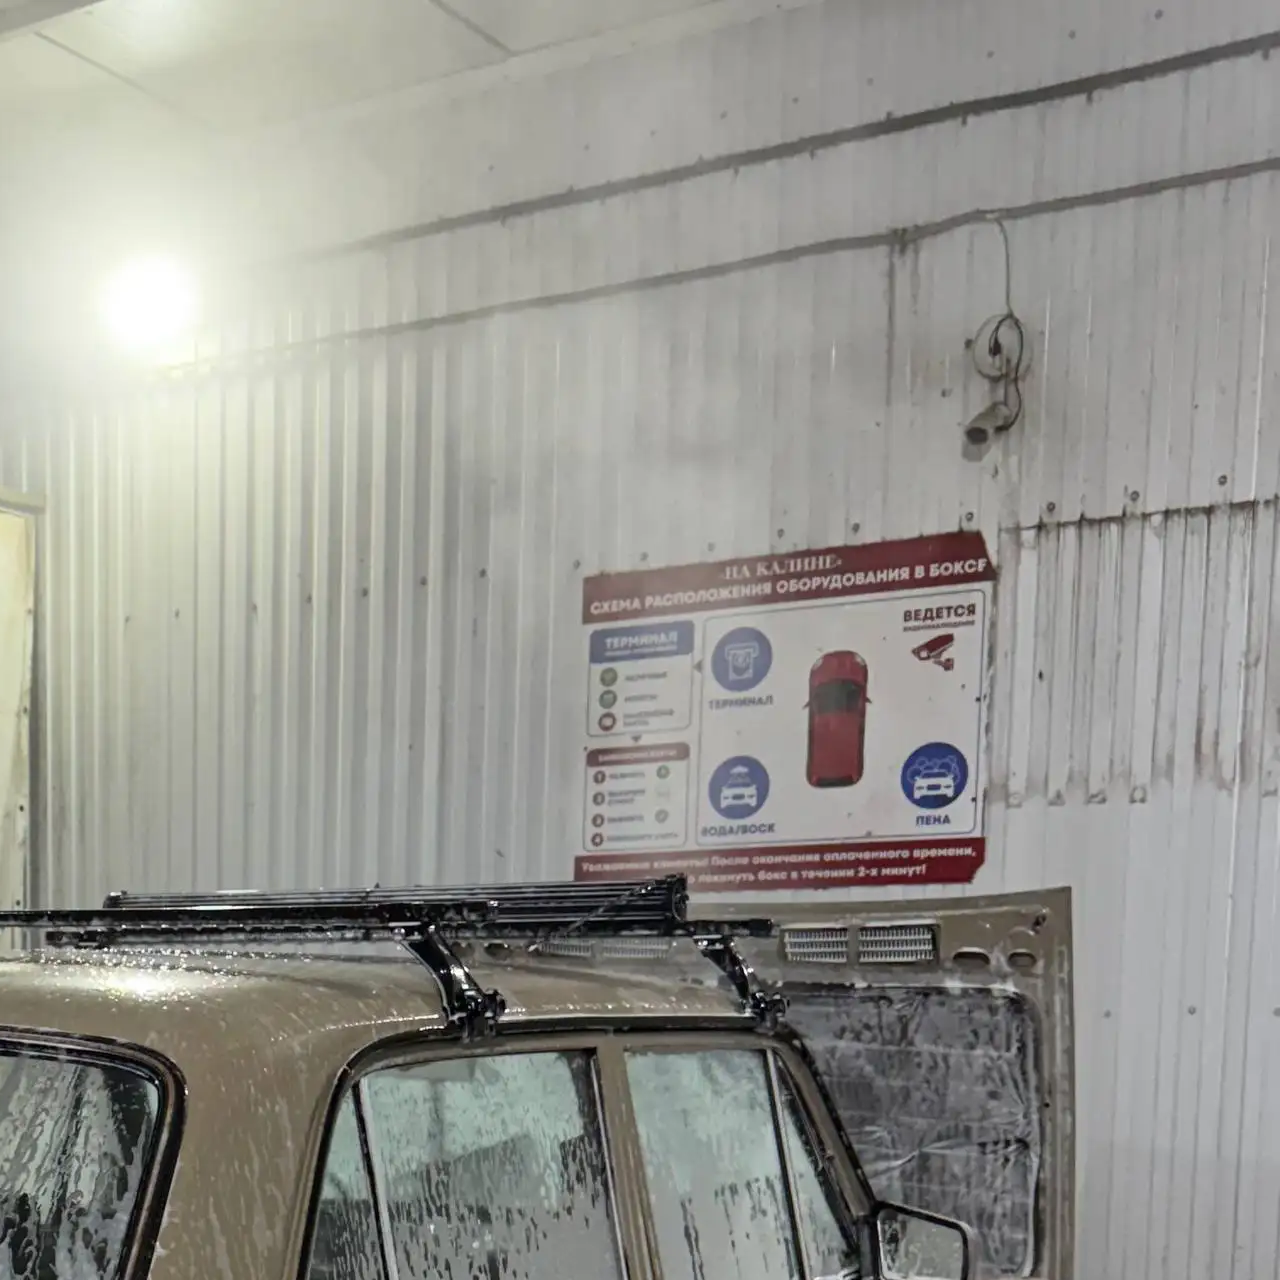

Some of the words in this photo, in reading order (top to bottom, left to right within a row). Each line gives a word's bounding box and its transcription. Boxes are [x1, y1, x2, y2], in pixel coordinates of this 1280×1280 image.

[589, 596, 641, 615] СХЕМА
[644, 581, 771, 609] РАСПОЛОЖЕНИЯ
[776, 566, 910, 594] ОБОРУДОВАНИЯ
[914, 564, 925, 579] В
[903, 602, 976, 622] ВЕДЕТСЯ
[604, 630, 678, 649] ТЕРМИНАЛ
[708, 695, 774, 711] ТЕРМИНАЛ
[915, 814, 951, 827] ПЕНА
[711, 855, 749, 868] После
[823, 850, 910, 863] оплаченного
[698, 872, 754, 885] покинуть
[757, 868, 788, 882] бокс
[857, 864, 878, 878] 2-х
[880, 863, 927, 879] минут!
